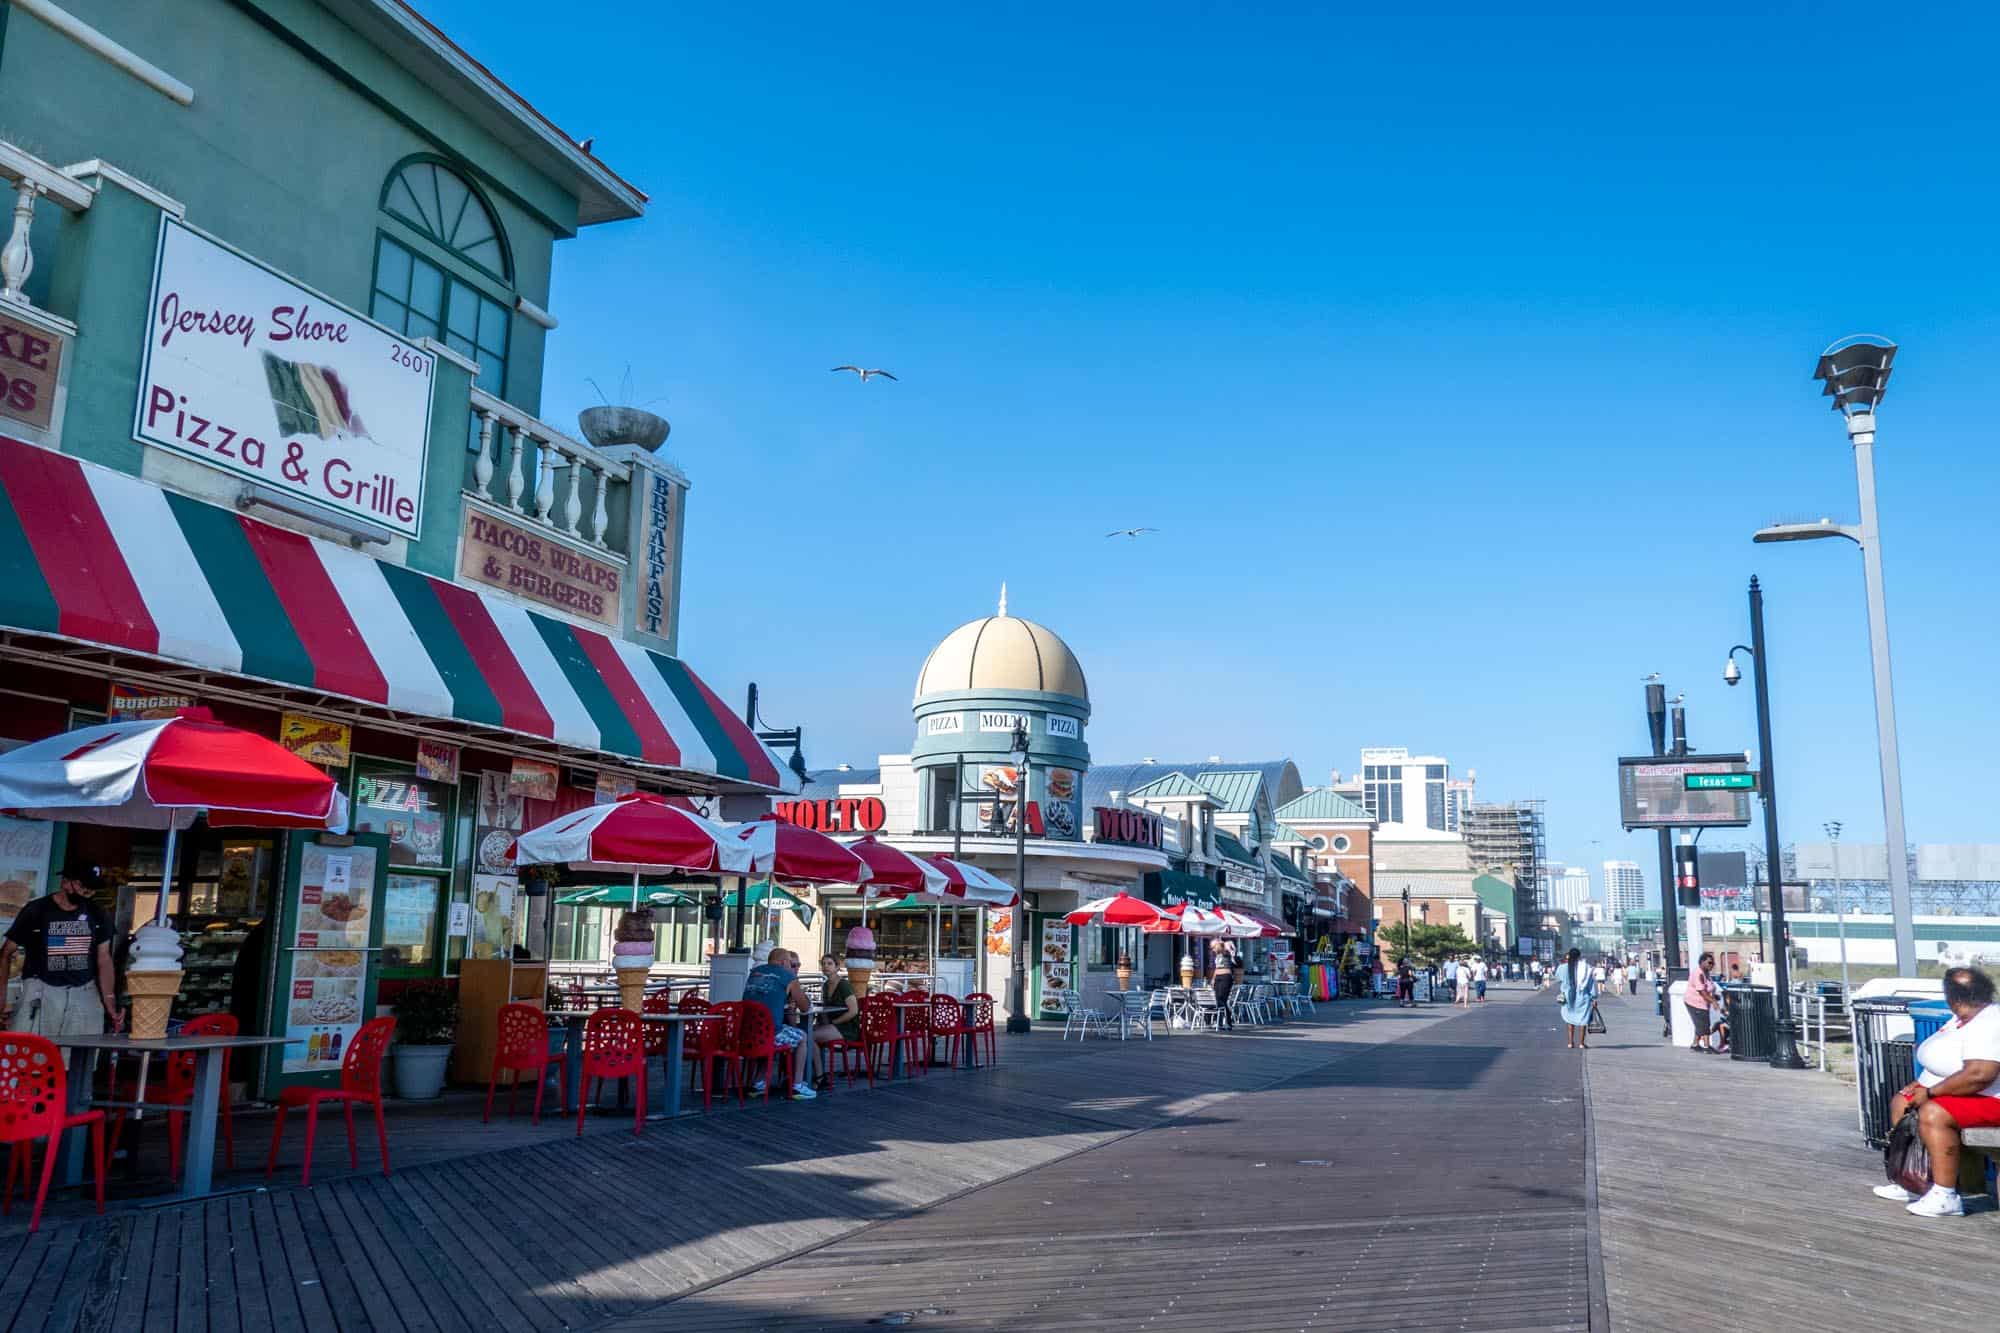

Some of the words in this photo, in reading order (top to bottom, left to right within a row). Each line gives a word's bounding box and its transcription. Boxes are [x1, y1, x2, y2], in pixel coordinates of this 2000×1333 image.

[160, 292, 256, 347] Jersey
[268, 305, 350, 343] Shore
[391, 344, 431, 377] 2601
[147, 384, 265, 467] Pizza
[280, 441, 310, 486] &
[322, 458, 415, 523] Grille
[471, 516, 545, 568] TACOS,
[550, 549, 618, 593] WRAPS
[646, 475, 670, 635] BREAKFAST
[482, 555, 501, 581] &
[508, 563, 604, 617] BURGERS
[113, 695, 189, 709] BURGERS
[930, 714, 959, 731] PIZZA
[1051, 717, 1076, 735] PIZZA
[356, 775, 420, 813] PIZZA
[1699, 776, 1727, 787] Texas
[776, 797, 885, 832] MOLTO
